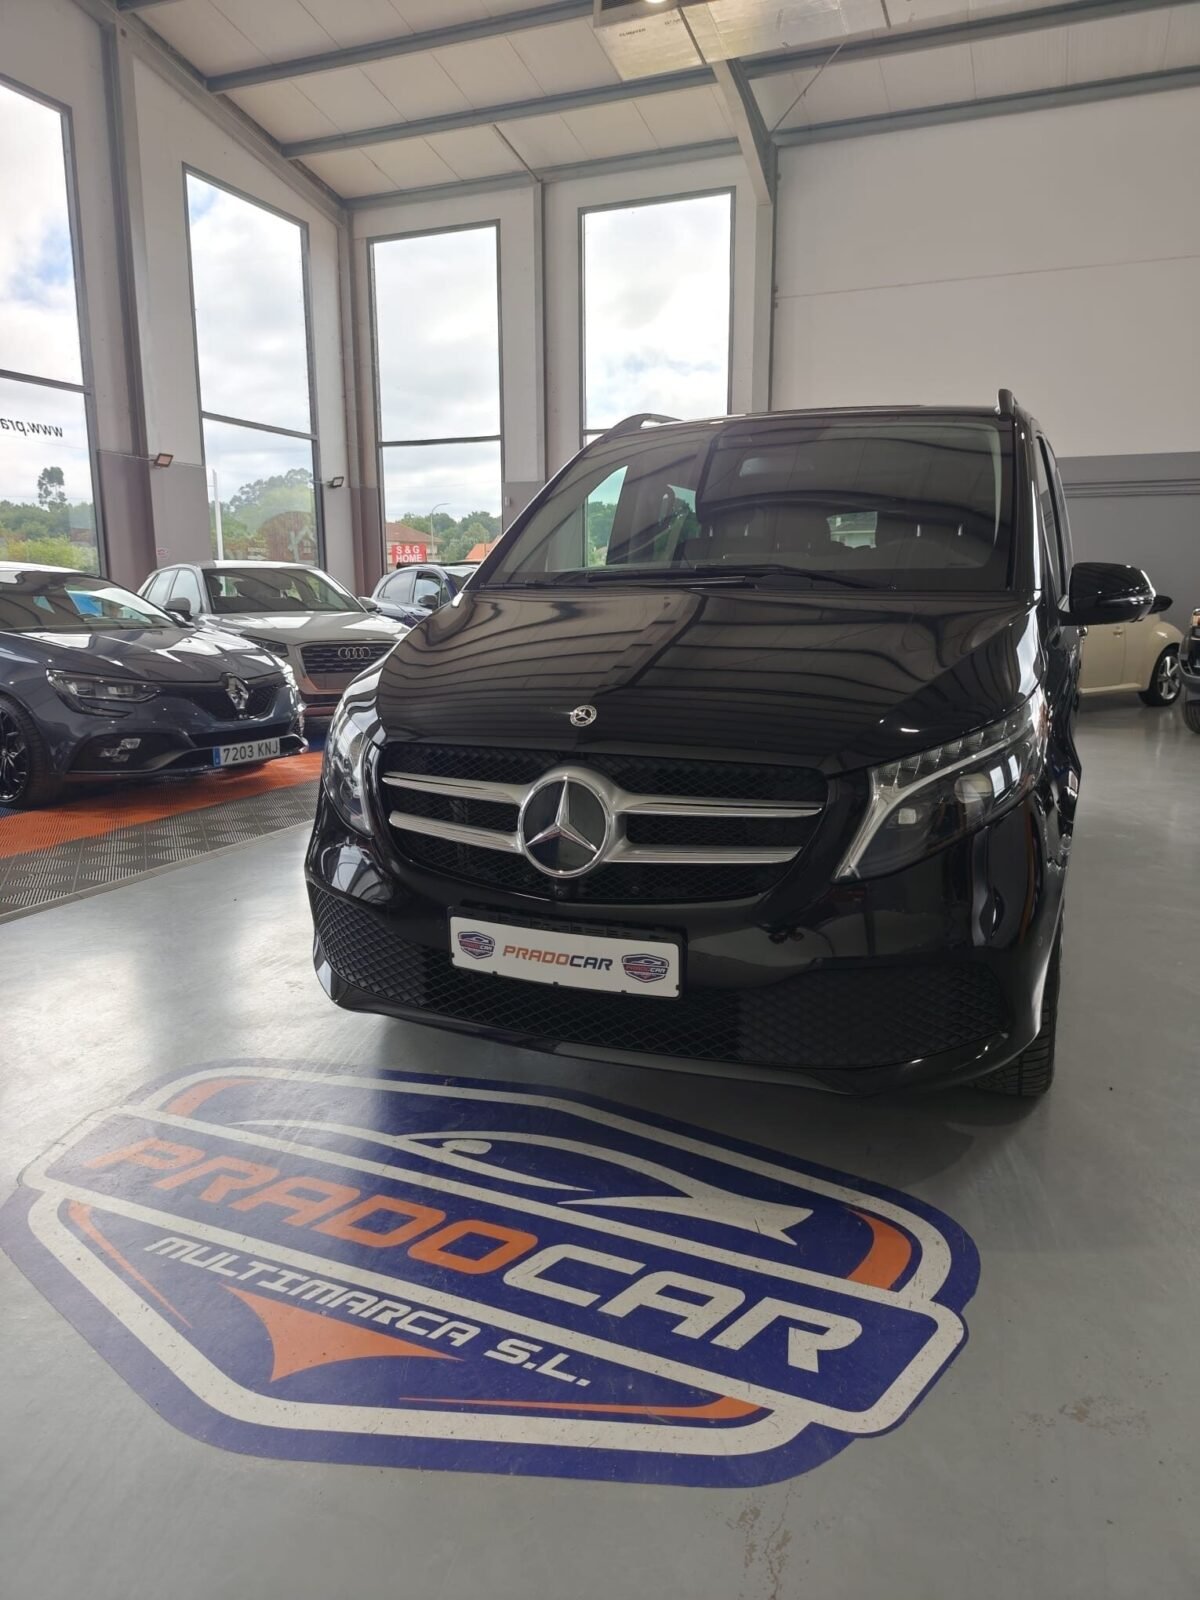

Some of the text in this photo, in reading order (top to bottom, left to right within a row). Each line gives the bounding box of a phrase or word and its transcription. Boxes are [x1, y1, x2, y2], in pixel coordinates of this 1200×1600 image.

[396, 545, 420, 554] S & G
[396, 554, 423, 563] HOME
[223, 740, 278, 762] 7203 KNJ
[502, 945, 613, 971] PRADOCAR
[80, 1136, 862, 1373] PRADOCAR
[143, 1236, 591, 1386] MULTIMARCA S.L.
